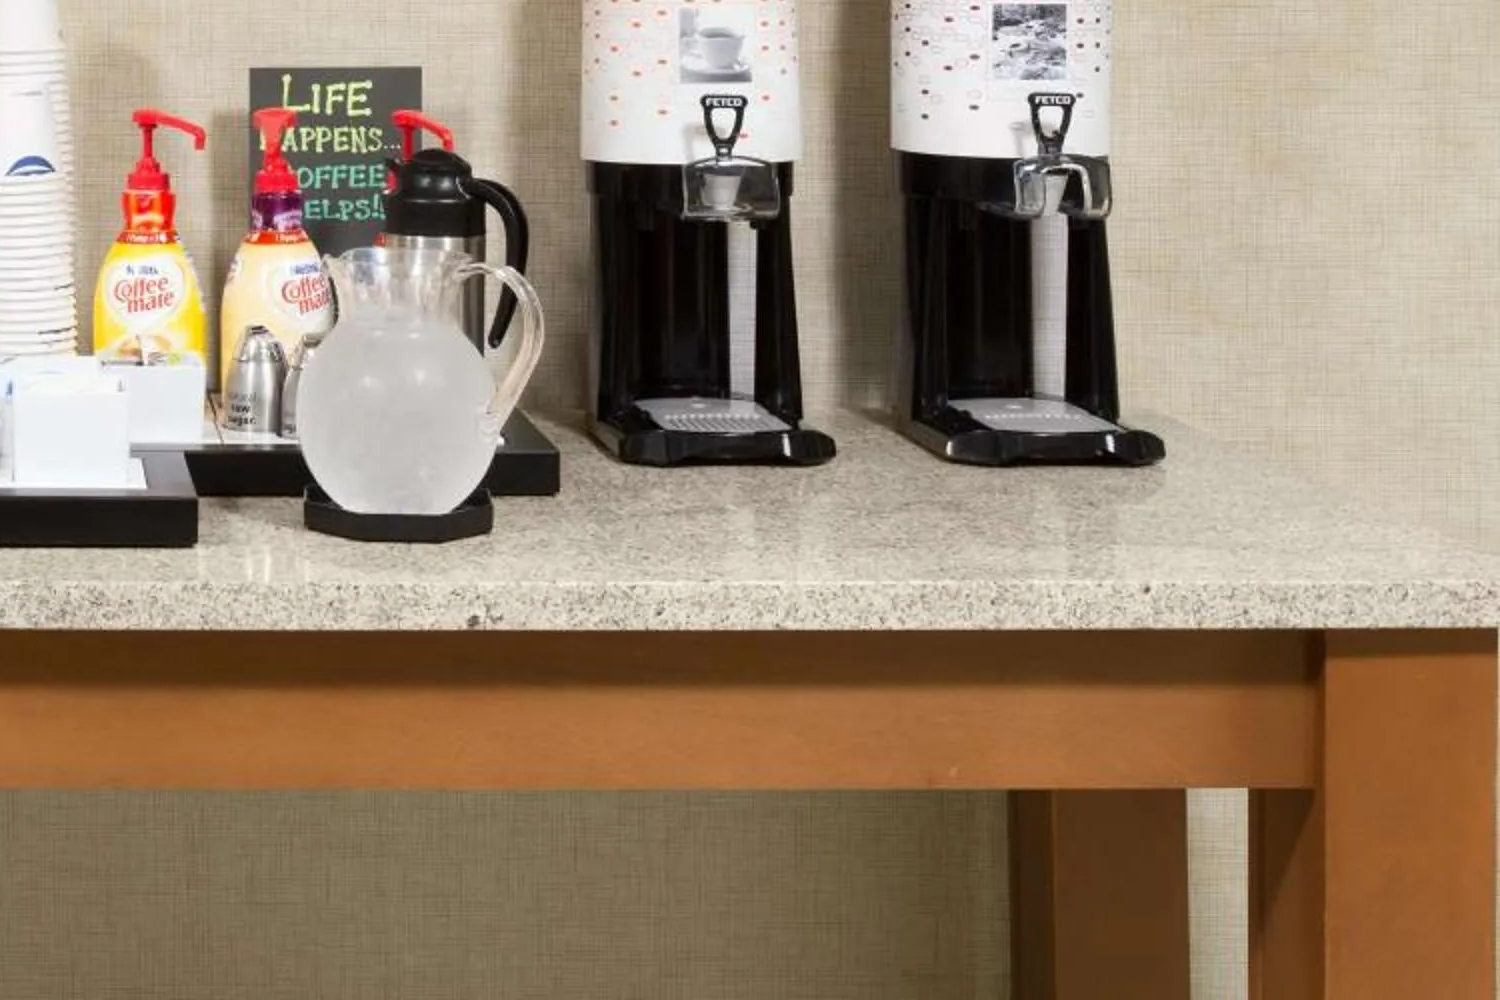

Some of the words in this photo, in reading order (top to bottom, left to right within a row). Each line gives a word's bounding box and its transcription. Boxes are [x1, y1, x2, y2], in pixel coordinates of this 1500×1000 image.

[281, 73, 373, 117] LIFE
[705, 98, 743, 107] FETCO
[1035, 96, 1071, 105] FETCO
[296, 164, 387, 190] OFFEE
[303, 193, 387, 222] ELPS!!
[113, 276, 170, 304] Coffee
[126, 290, 175, 315] mate
